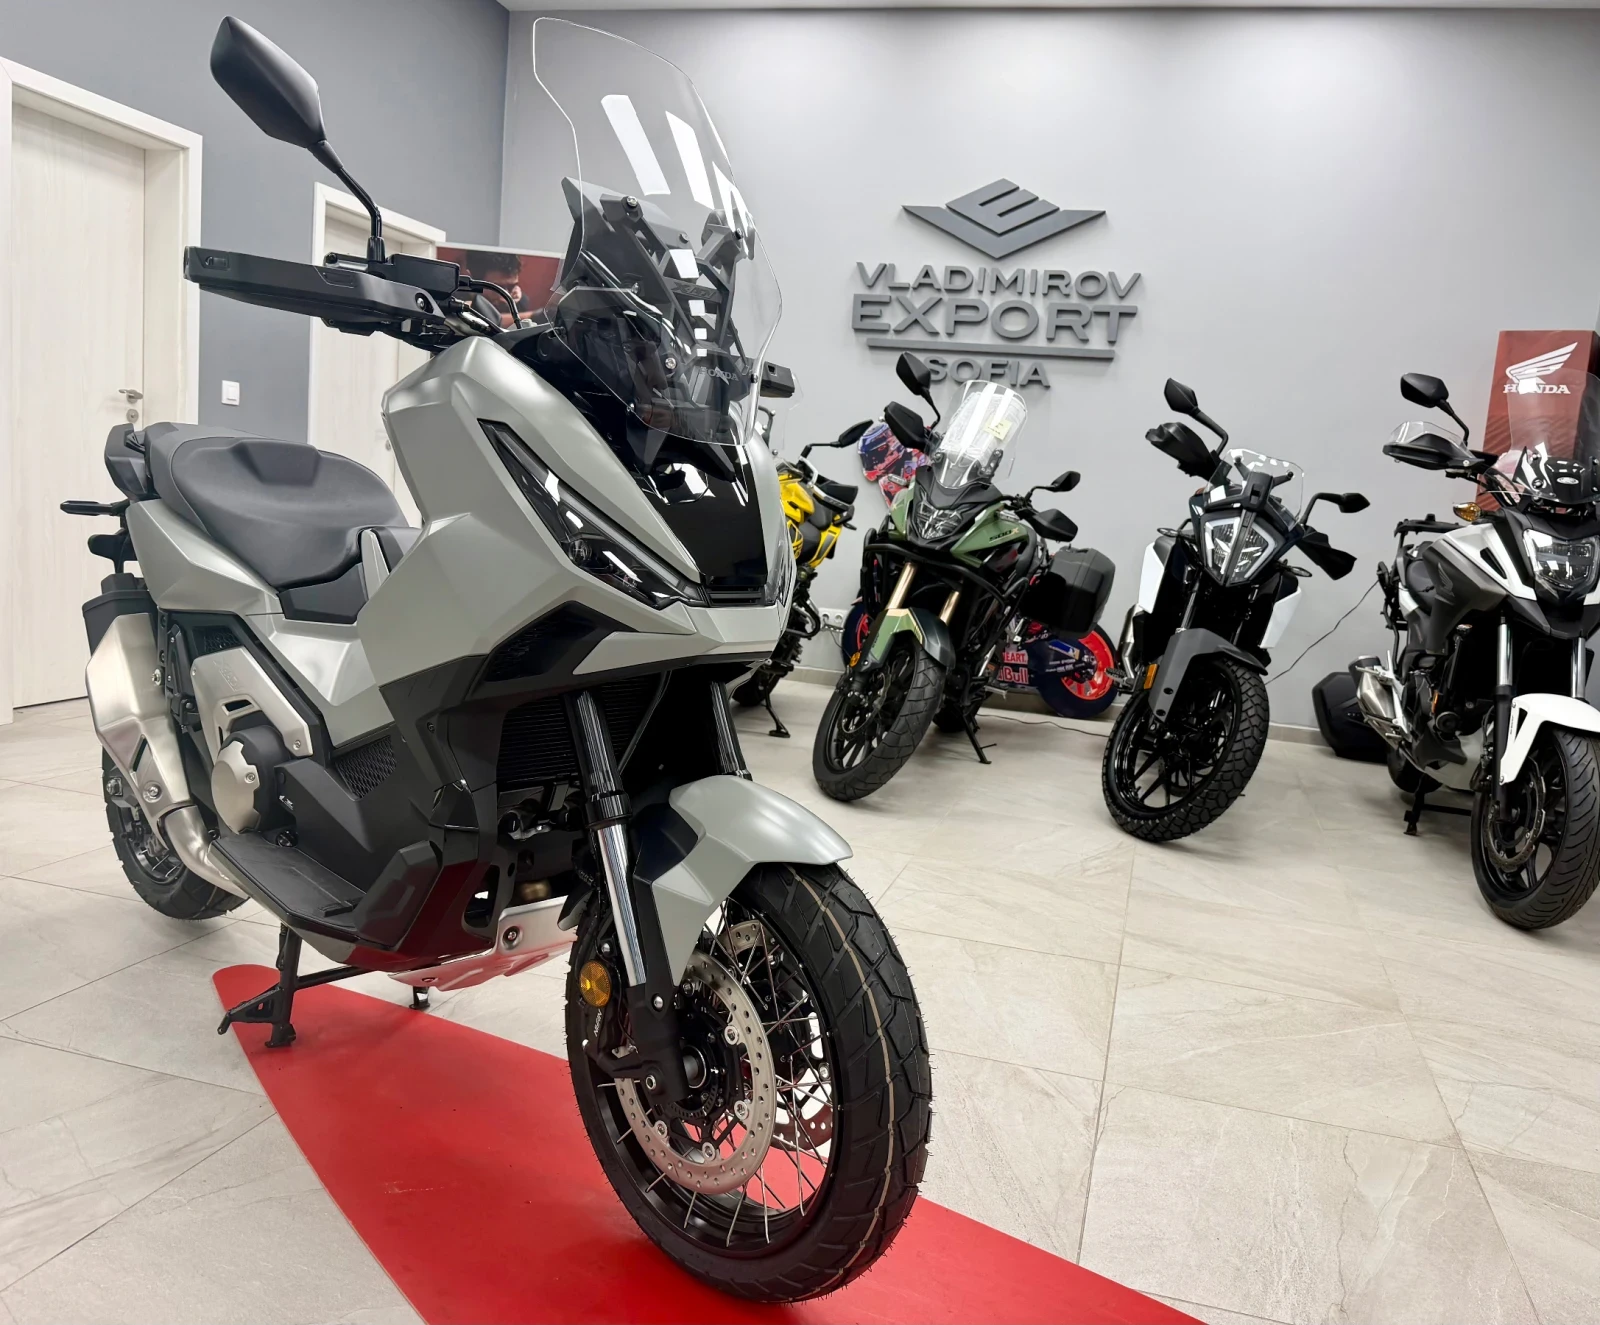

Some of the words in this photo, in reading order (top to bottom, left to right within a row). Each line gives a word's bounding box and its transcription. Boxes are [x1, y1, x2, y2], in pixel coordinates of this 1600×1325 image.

[855, 261, 1141, 298] VLADIMIROV
[852, 293, 1138, 343] EXPORT
[926, 355, 1051, 387] SOFIA
[1503, 384, 1571, 394] HNDA
